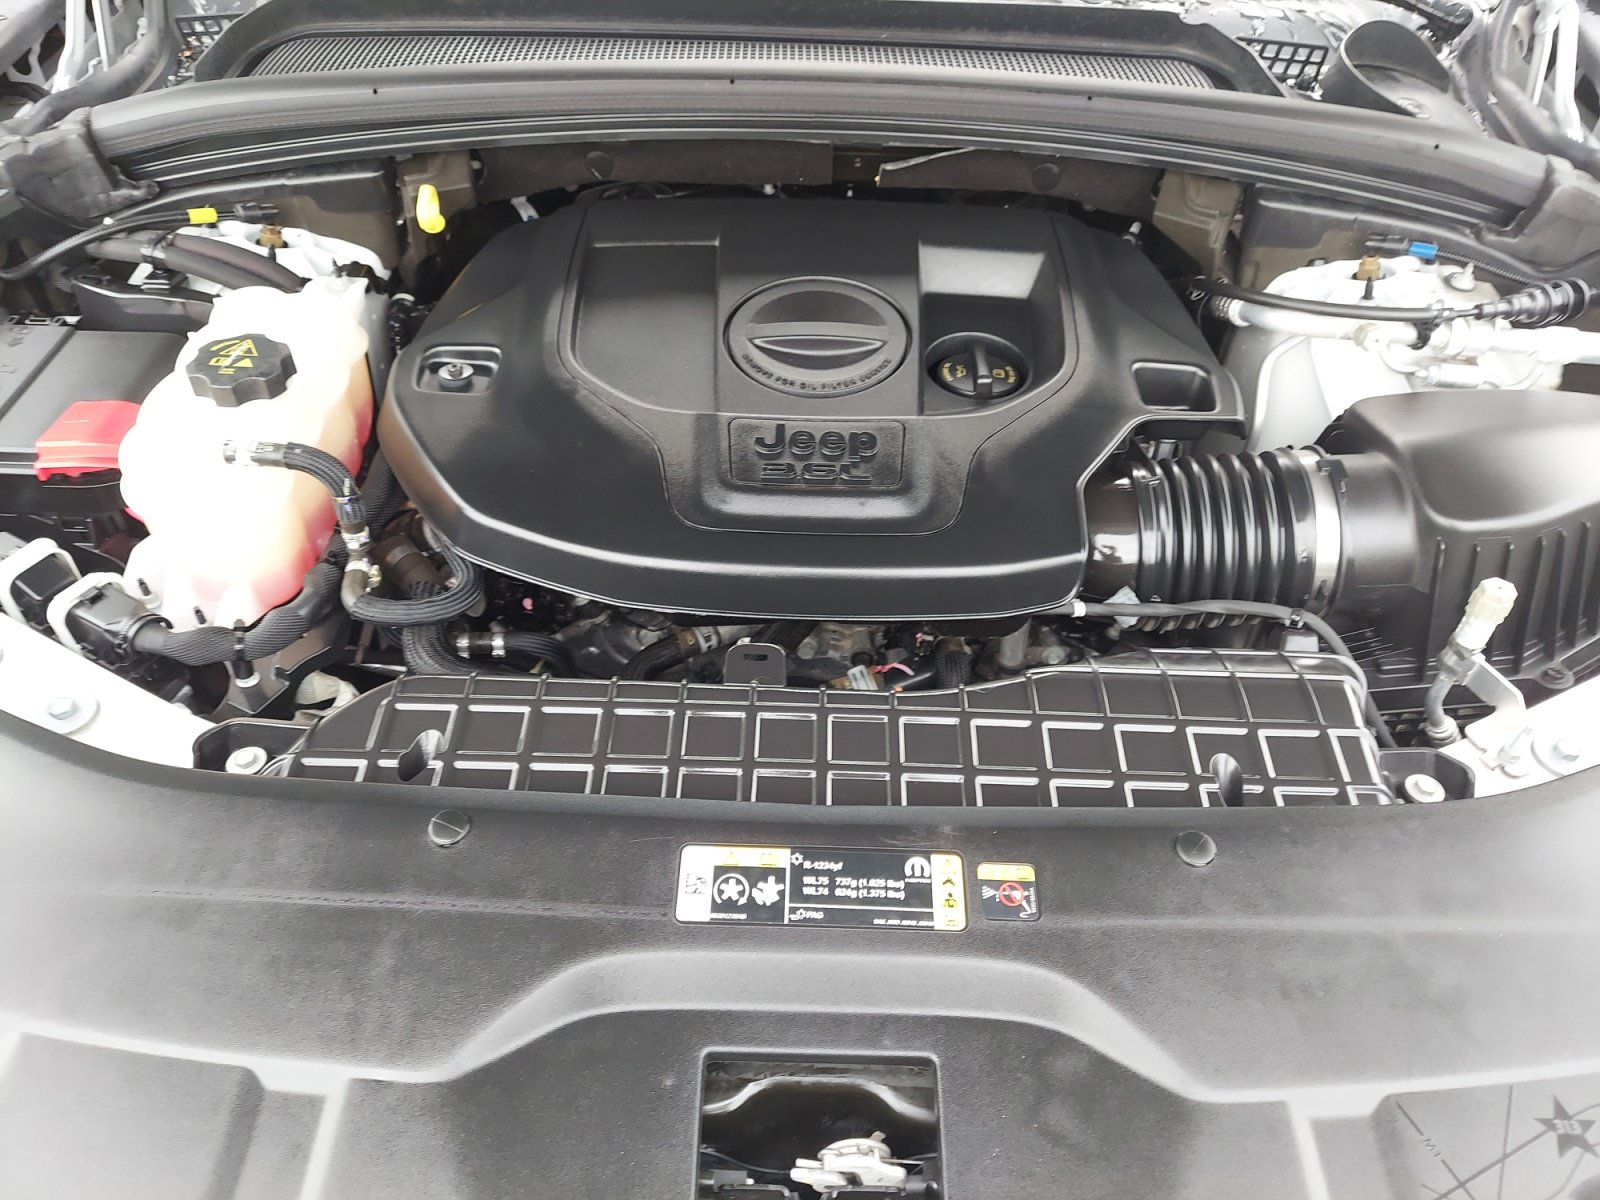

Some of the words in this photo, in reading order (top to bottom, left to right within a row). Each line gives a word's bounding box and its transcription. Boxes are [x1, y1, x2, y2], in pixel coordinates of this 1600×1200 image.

[800, 381, 817, 390] OIL
[754, 423, 878, 464] Jeep
[1552, 1119, 1583, 1134] 313
